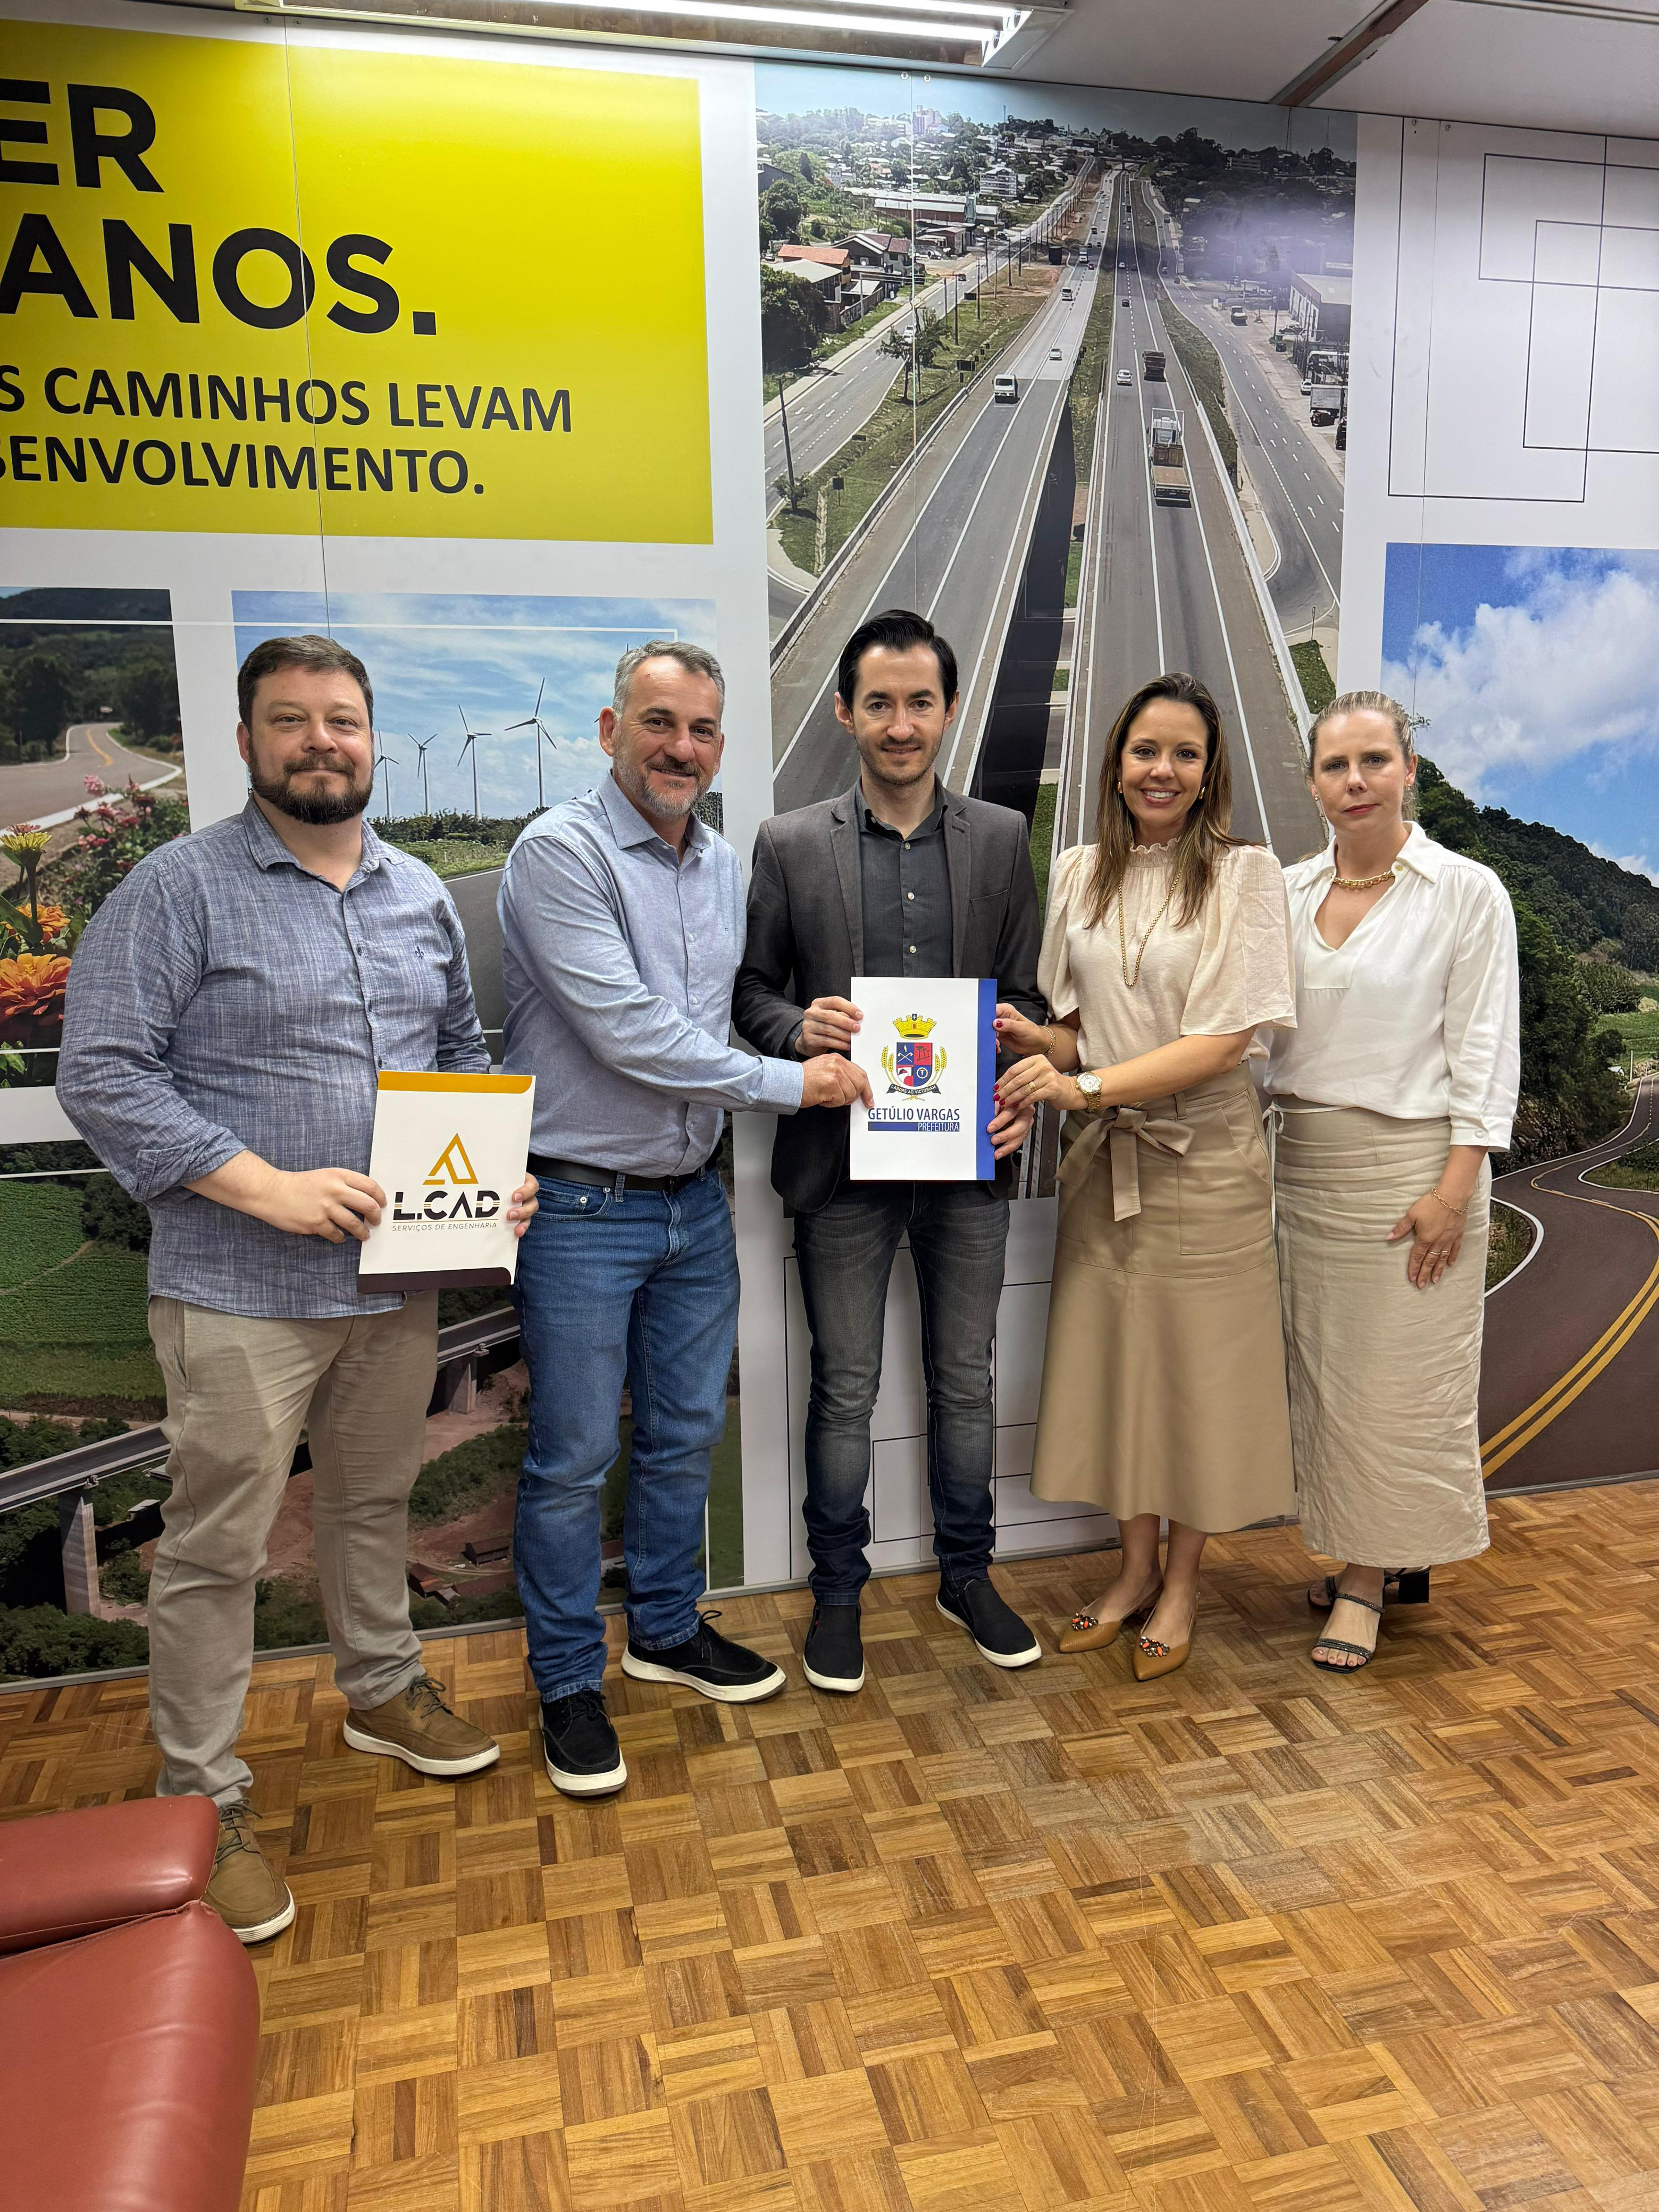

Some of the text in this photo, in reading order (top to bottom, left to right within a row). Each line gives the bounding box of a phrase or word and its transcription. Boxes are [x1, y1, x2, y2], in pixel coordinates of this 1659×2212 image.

[0, 213, 437, 336] ANOS.
[44, 367, 370, 426] CAMINHOS
[389, 382, 572, 432] LEVAM
[0, 435, 484, 495] ENVOLVIMENTO.
[868, 1105, 960, 1120] GETÚLIO VARGAS
[918, 1122, 959, 1132] PREFEITURA
[393, 1191, 500, 1220] L.CAD
